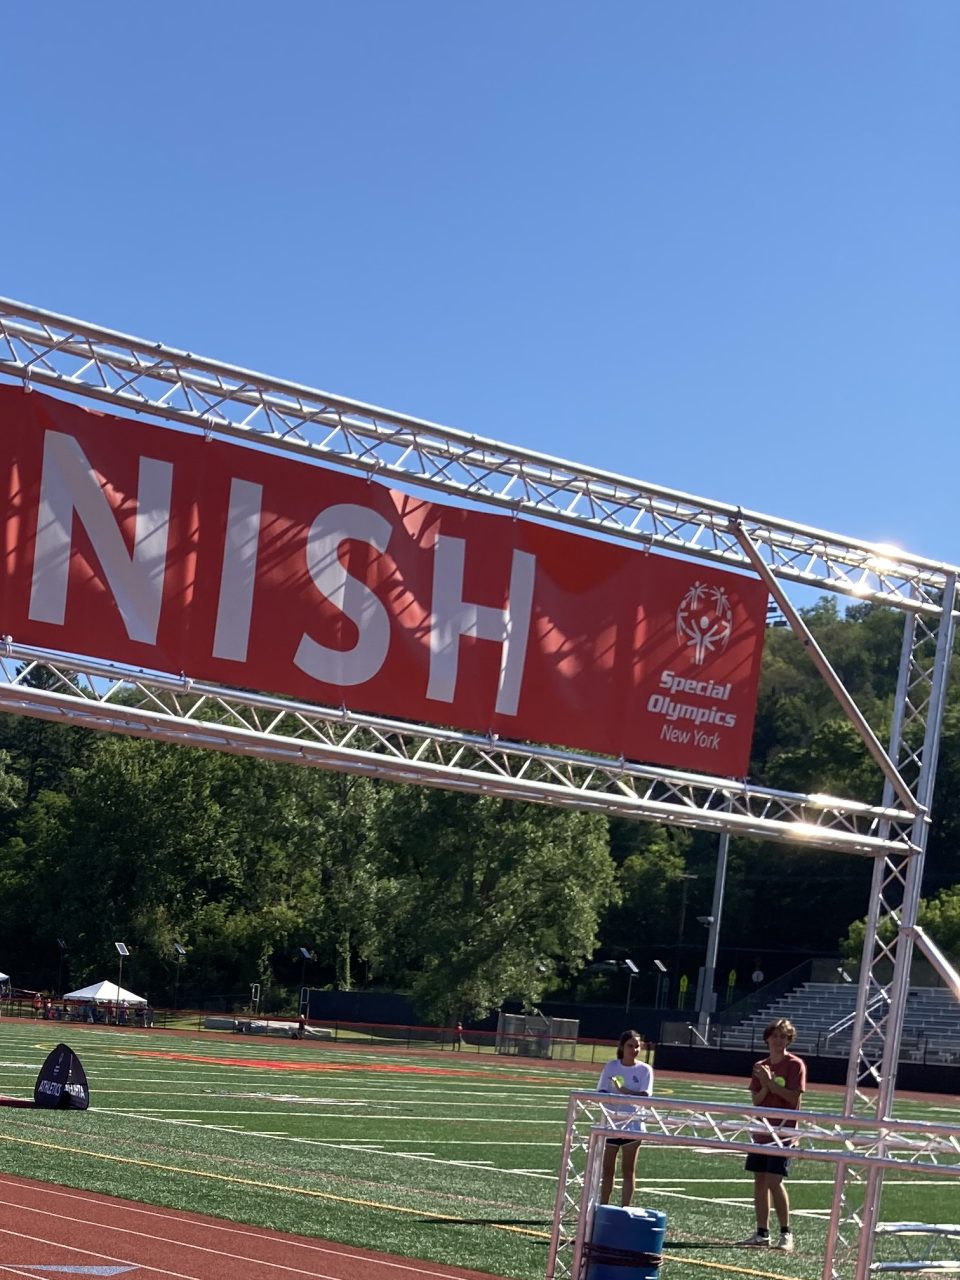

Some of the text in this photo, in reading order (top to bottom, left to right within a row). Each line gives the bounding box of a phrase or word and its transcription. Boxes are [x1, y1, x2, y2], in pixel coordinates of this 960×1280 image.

[659, 670, 732, 701] Special
[647, 694, 737, 728] Olympics
[660, 723, 721, 750] New York
